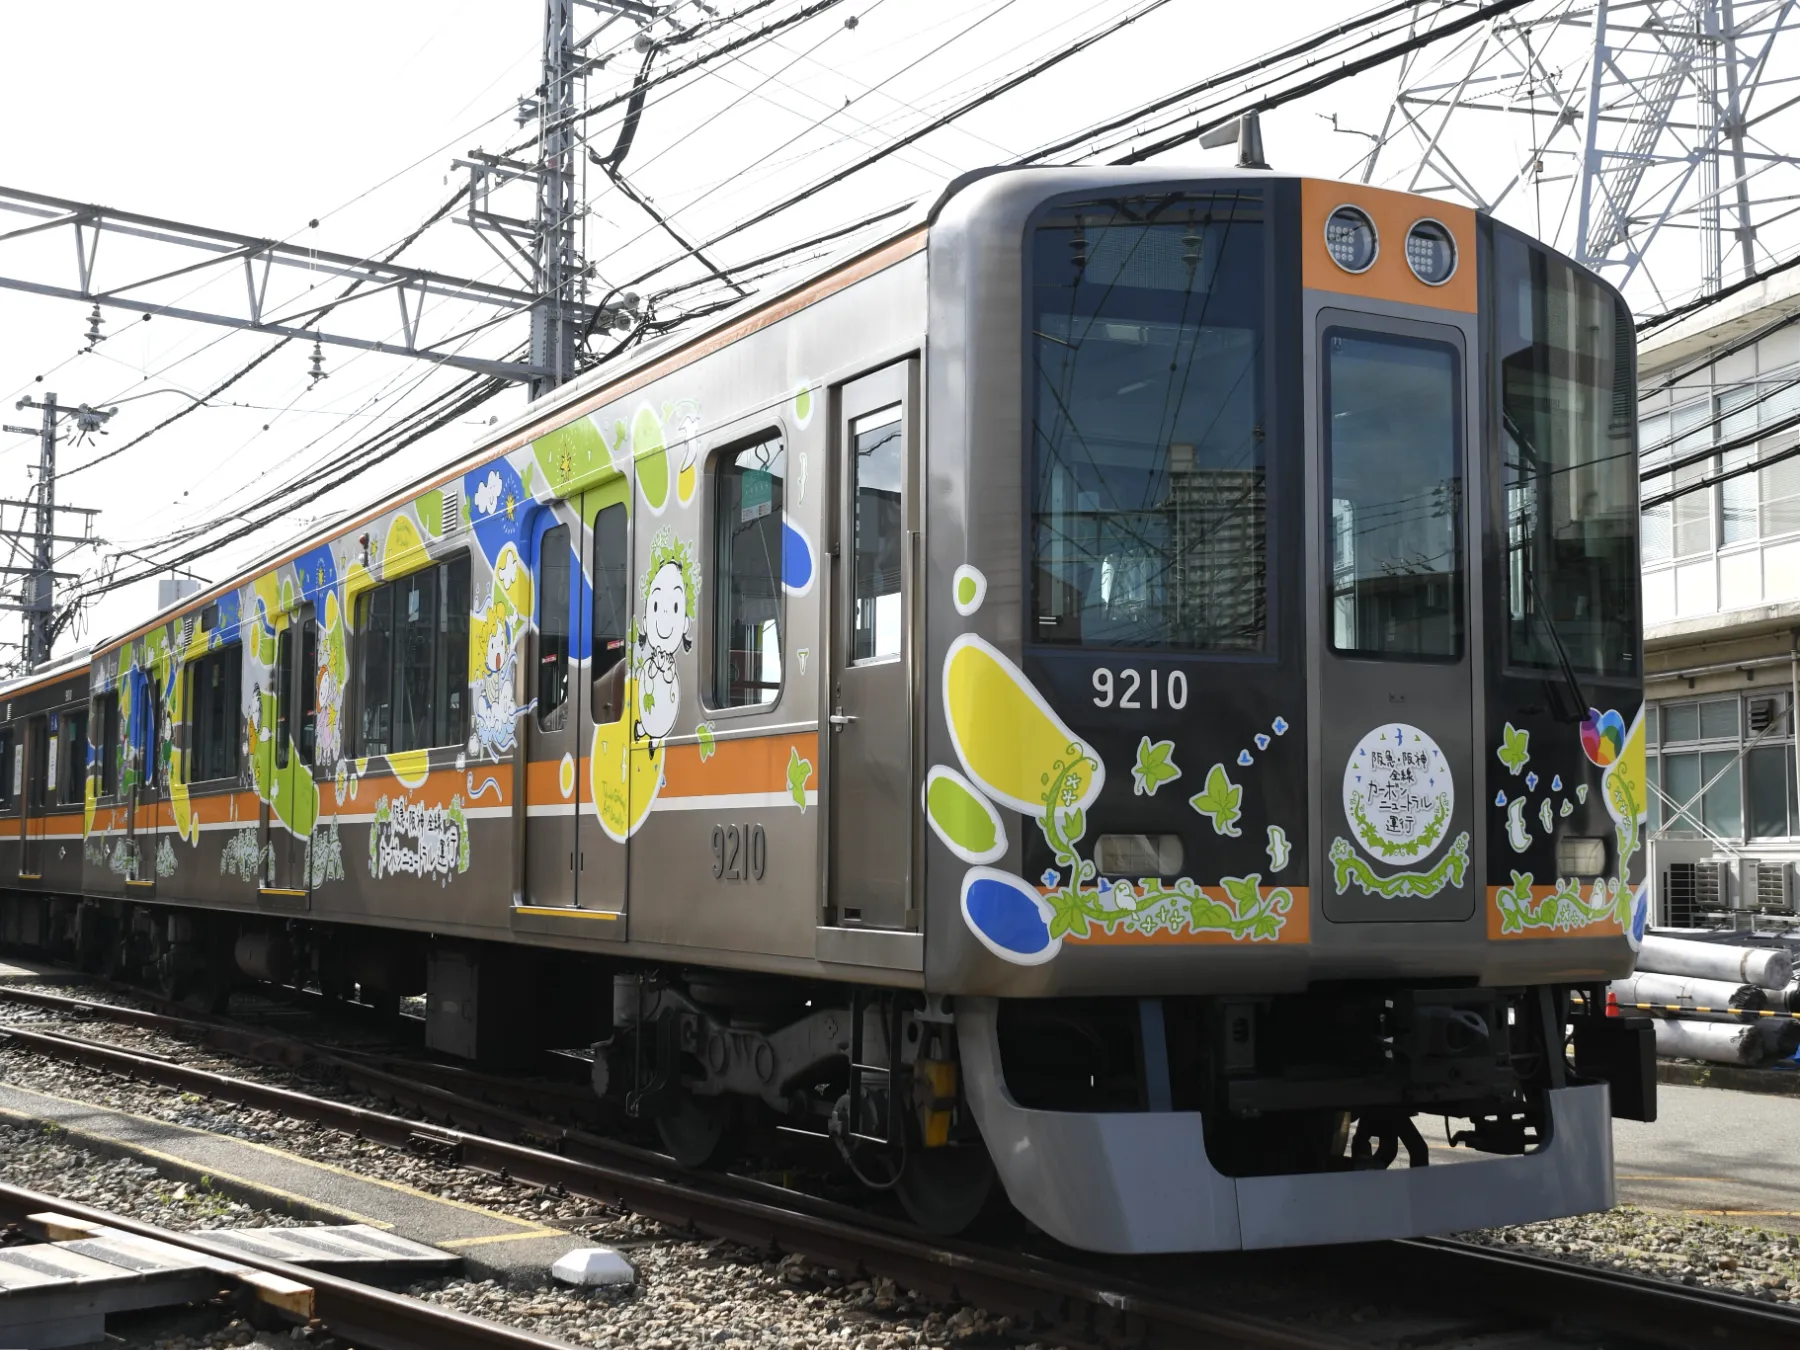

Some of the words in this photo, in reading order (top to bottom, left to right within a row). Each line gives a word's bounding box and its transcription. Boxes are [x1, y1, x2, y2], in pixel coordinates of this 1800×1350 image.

[1092, 667, 1188, 710] 9210
[1371, 749, 1428, 769] 阪急・阪神
[1389, 767, 1415, 783] 全線
[1367, 780, 1408, 802] カーボン
[1378, 793, 1433, 812] ニュートラル
[1385, 815, 1415, 834] 運行
[710, 823, 766, 881] 9210
